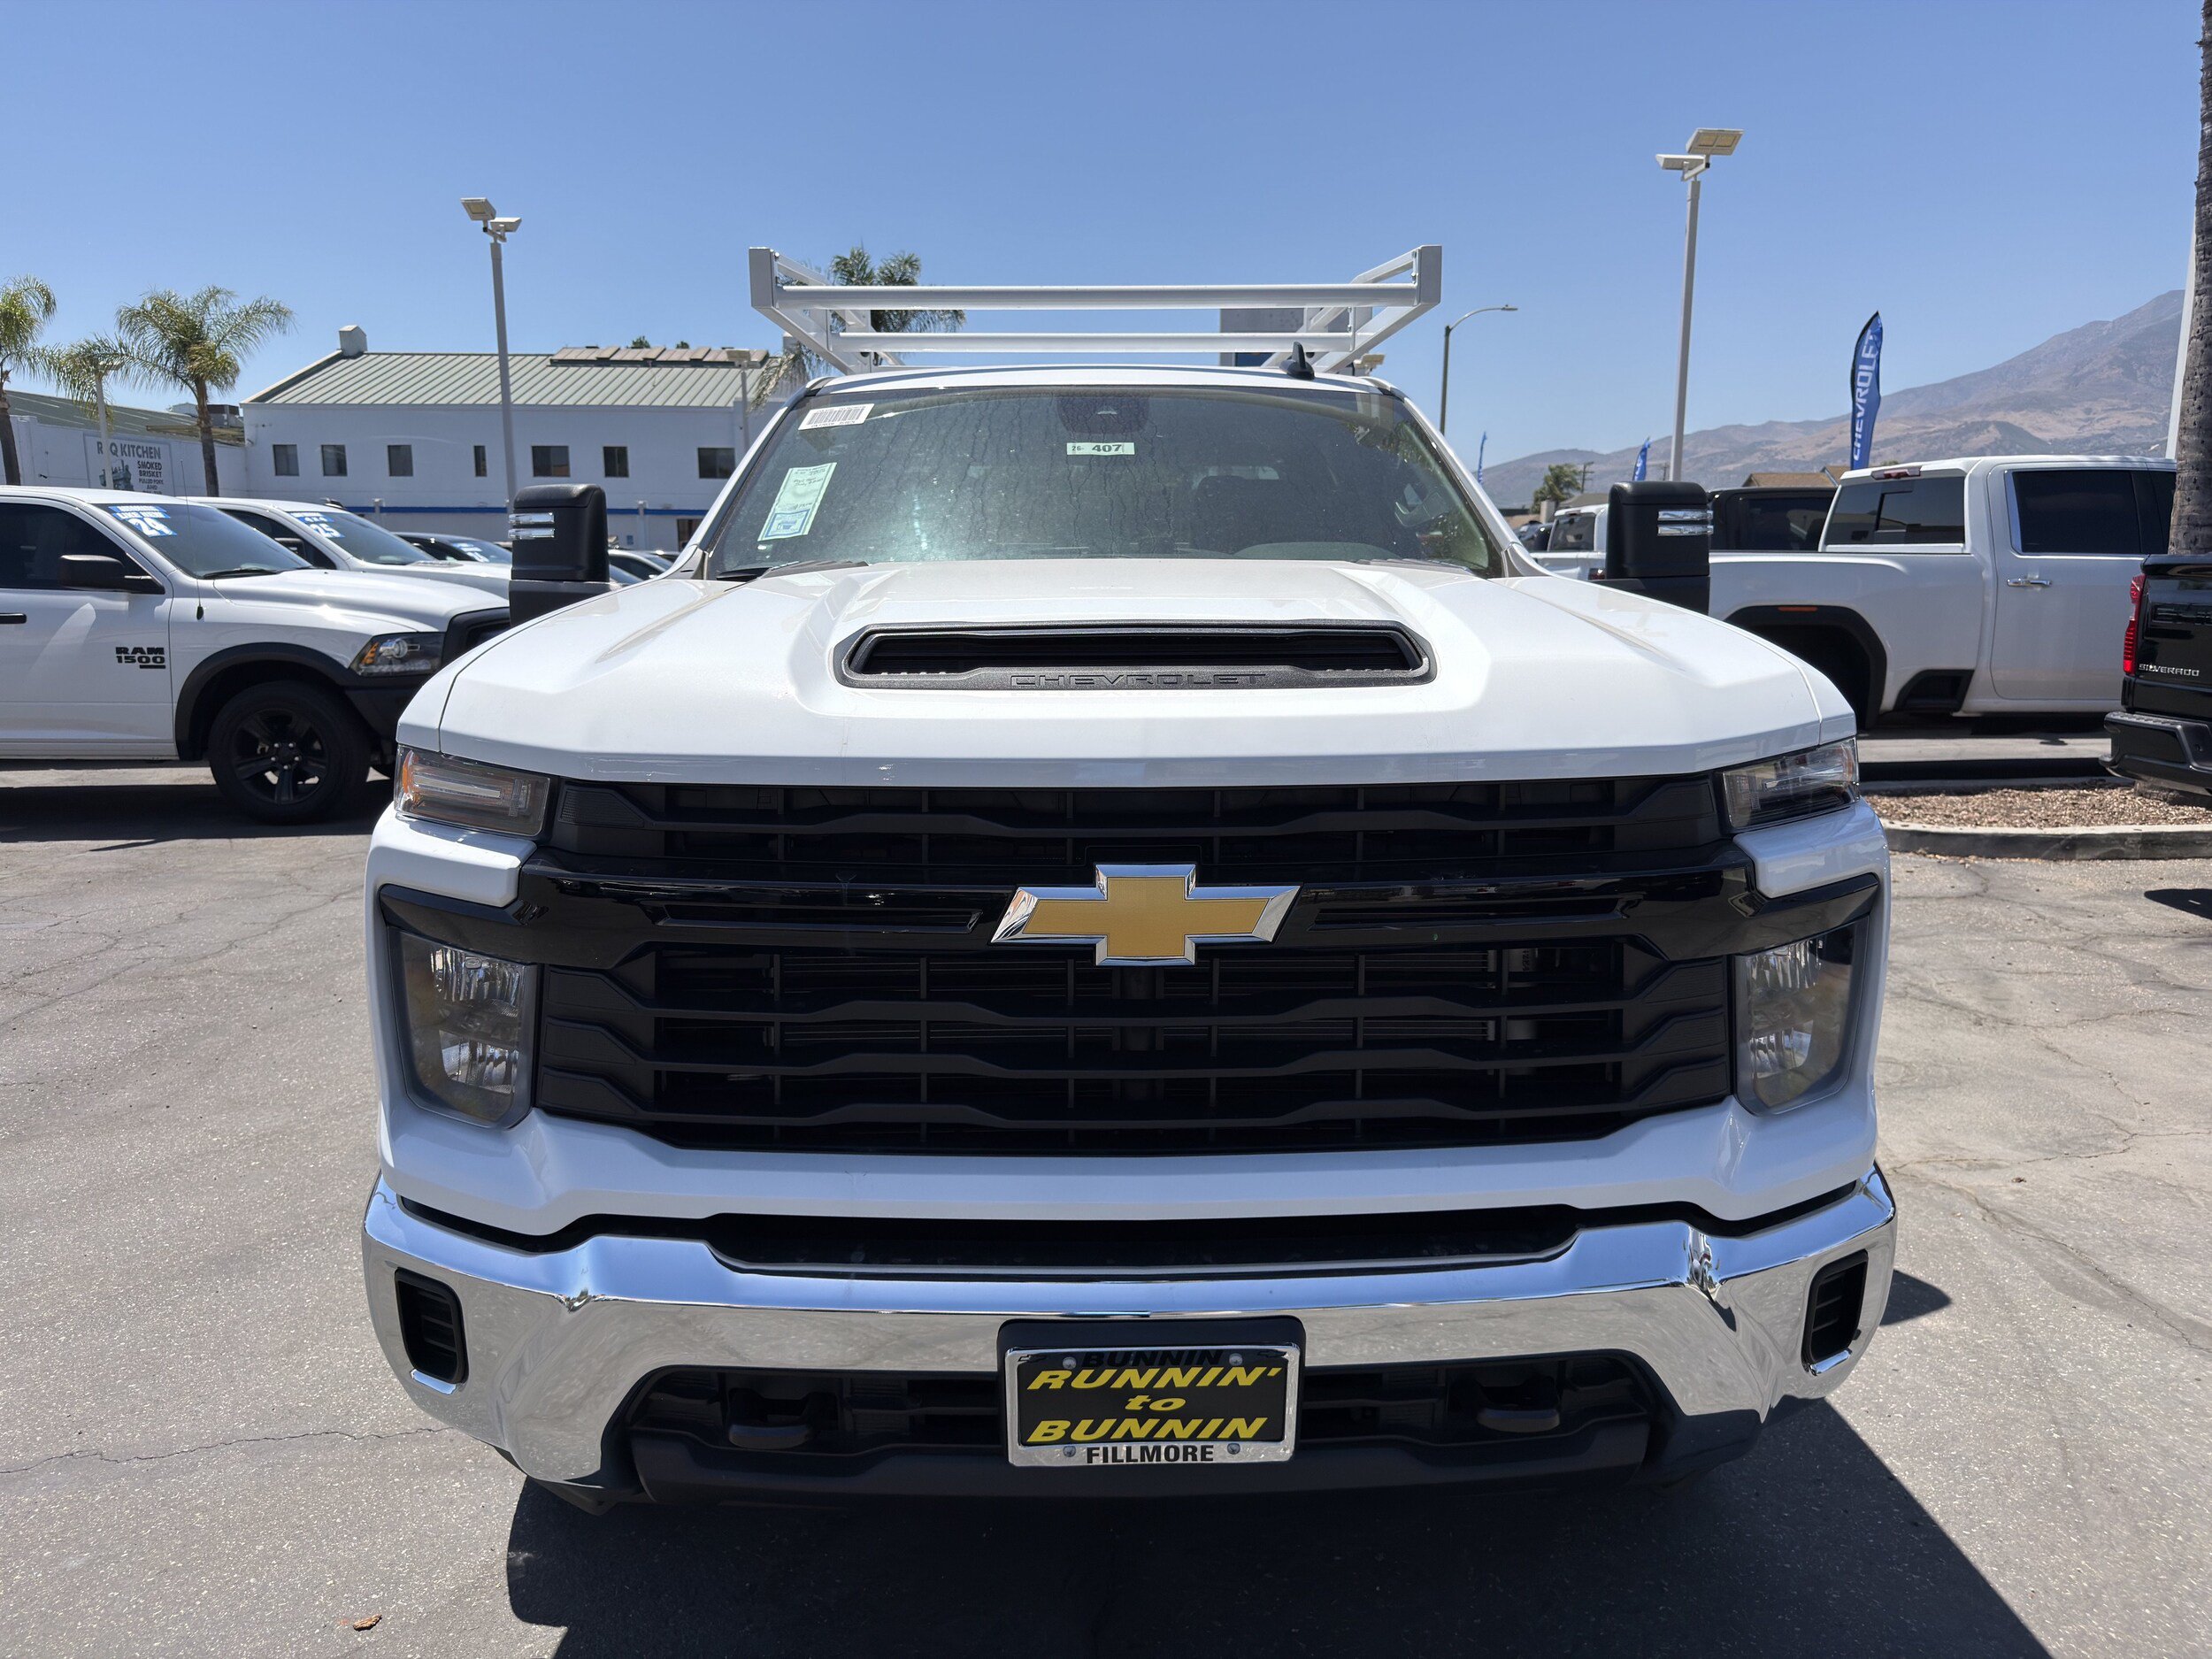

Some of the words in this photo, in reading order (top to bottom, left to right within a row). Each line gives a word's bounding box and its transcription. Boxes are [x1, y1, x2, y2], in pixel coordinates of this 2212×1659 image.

[96, 442, 118, 457] RQ
[120, 443, 161, 459] KITCHEN
[137, 460, 162, 471] SMOKED
[2139, 664, 2200, 677] SILVERADO
[1010, 674, 1266, 686] CHEVROLET
[1026, 1366, 1283, 1390] RUNNIN'
[1125, 1394, 1187, 1411] to
[1026, 1417, 1269, 1442] BUNNIN
[1086, 1444, 1215, 1463] FILLMORE
